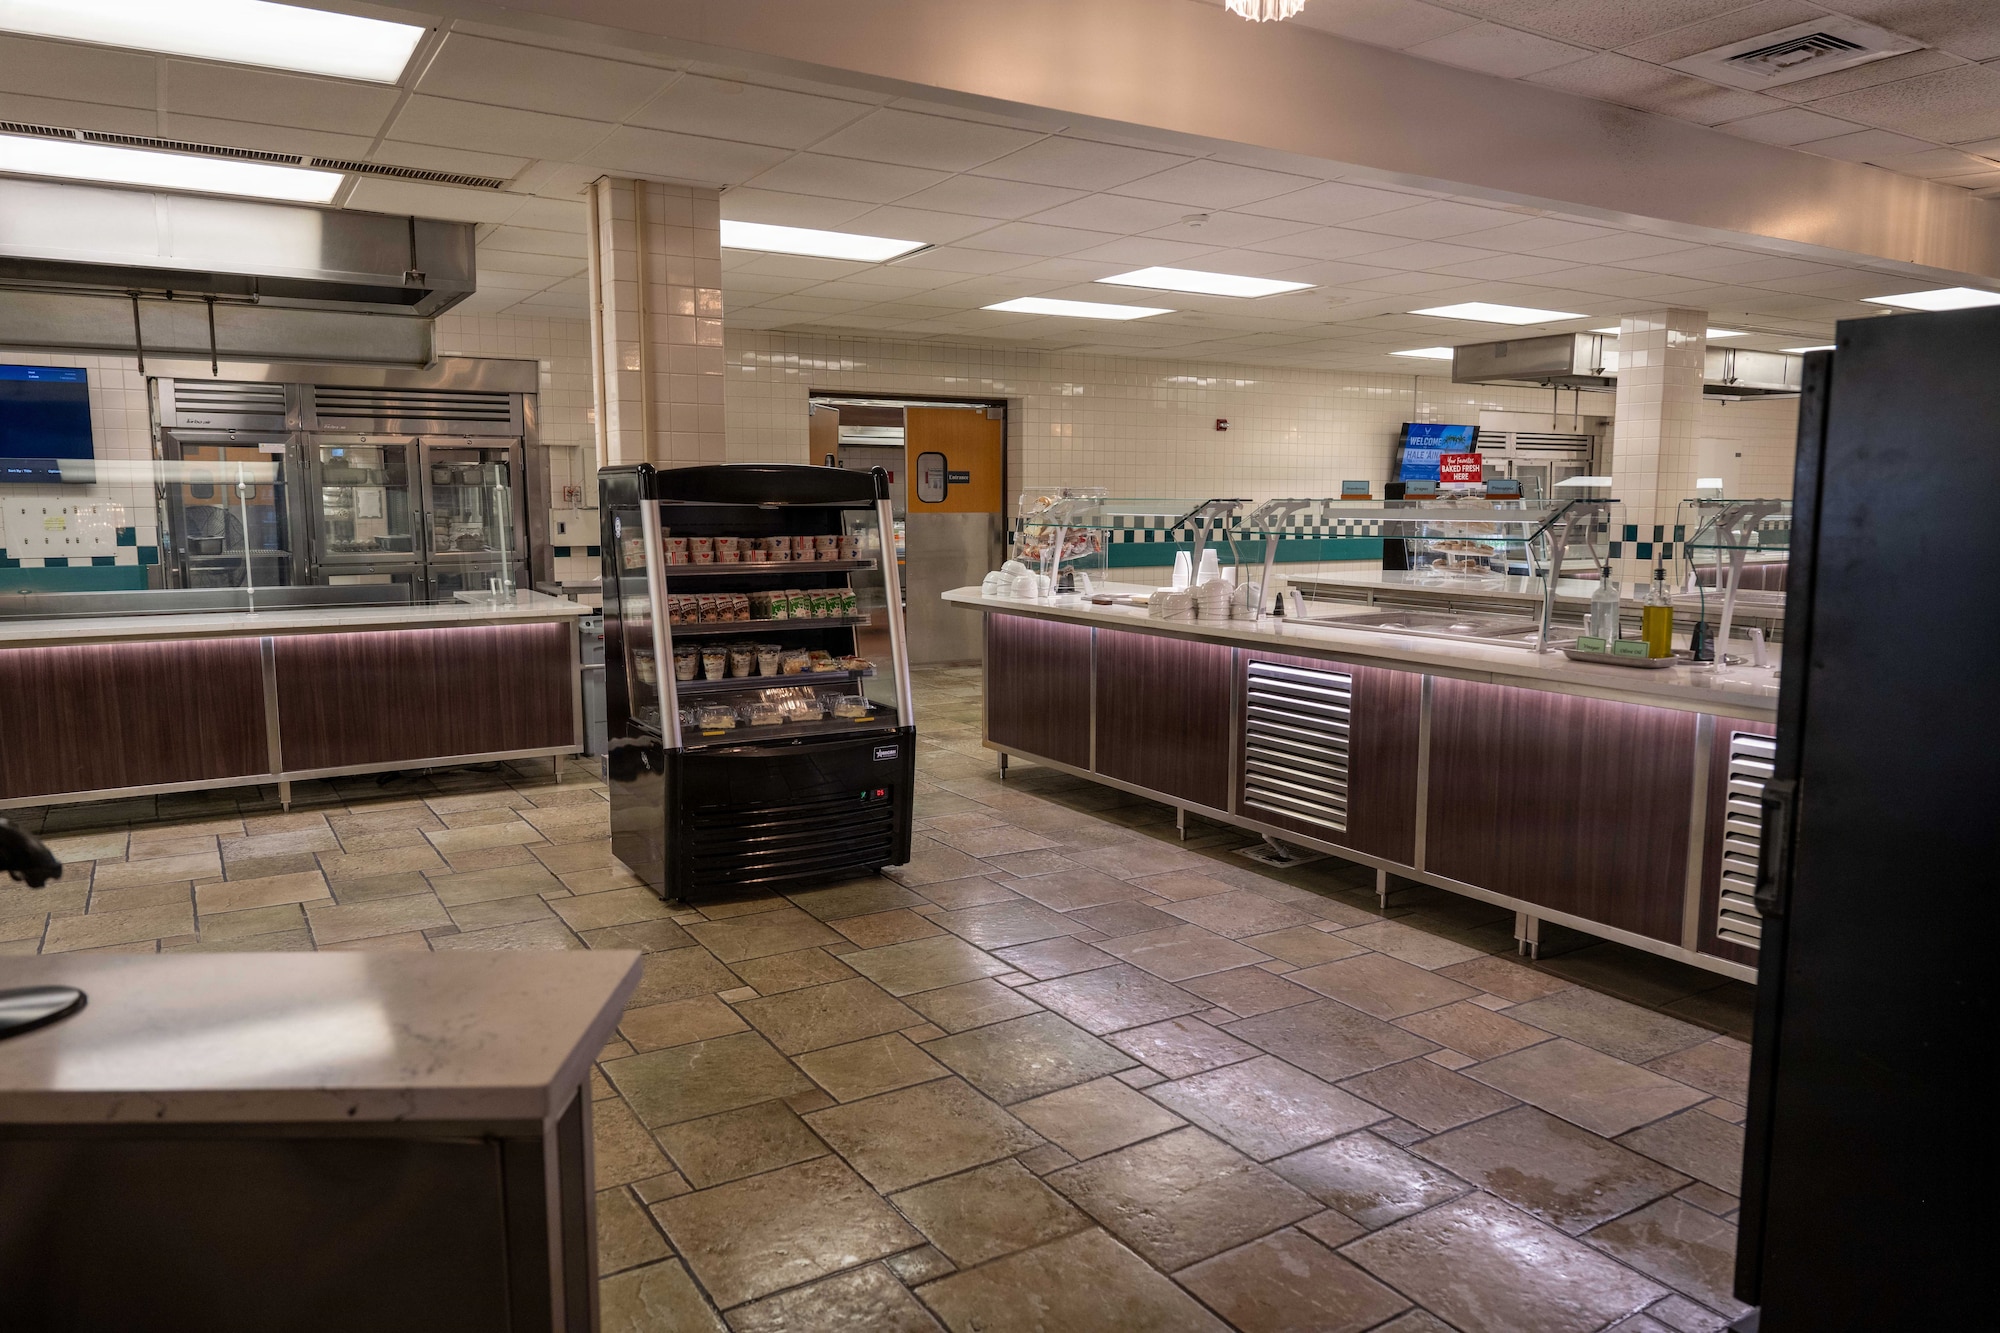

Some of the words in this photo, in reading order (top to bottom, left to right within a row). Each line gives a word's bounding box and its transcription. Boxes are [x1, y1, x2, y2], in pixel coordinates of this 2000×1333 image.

[1410, 436, 1442, 446] WELCOME
[1406, 450, 1425, 459] HALE
[1447, 456, 1457, 466] Your
[1441, 464, 1462, 473] BAKED
[1462, 464, 1480, 472] FRESH
[1453, 472, 1469, 480] HERE
